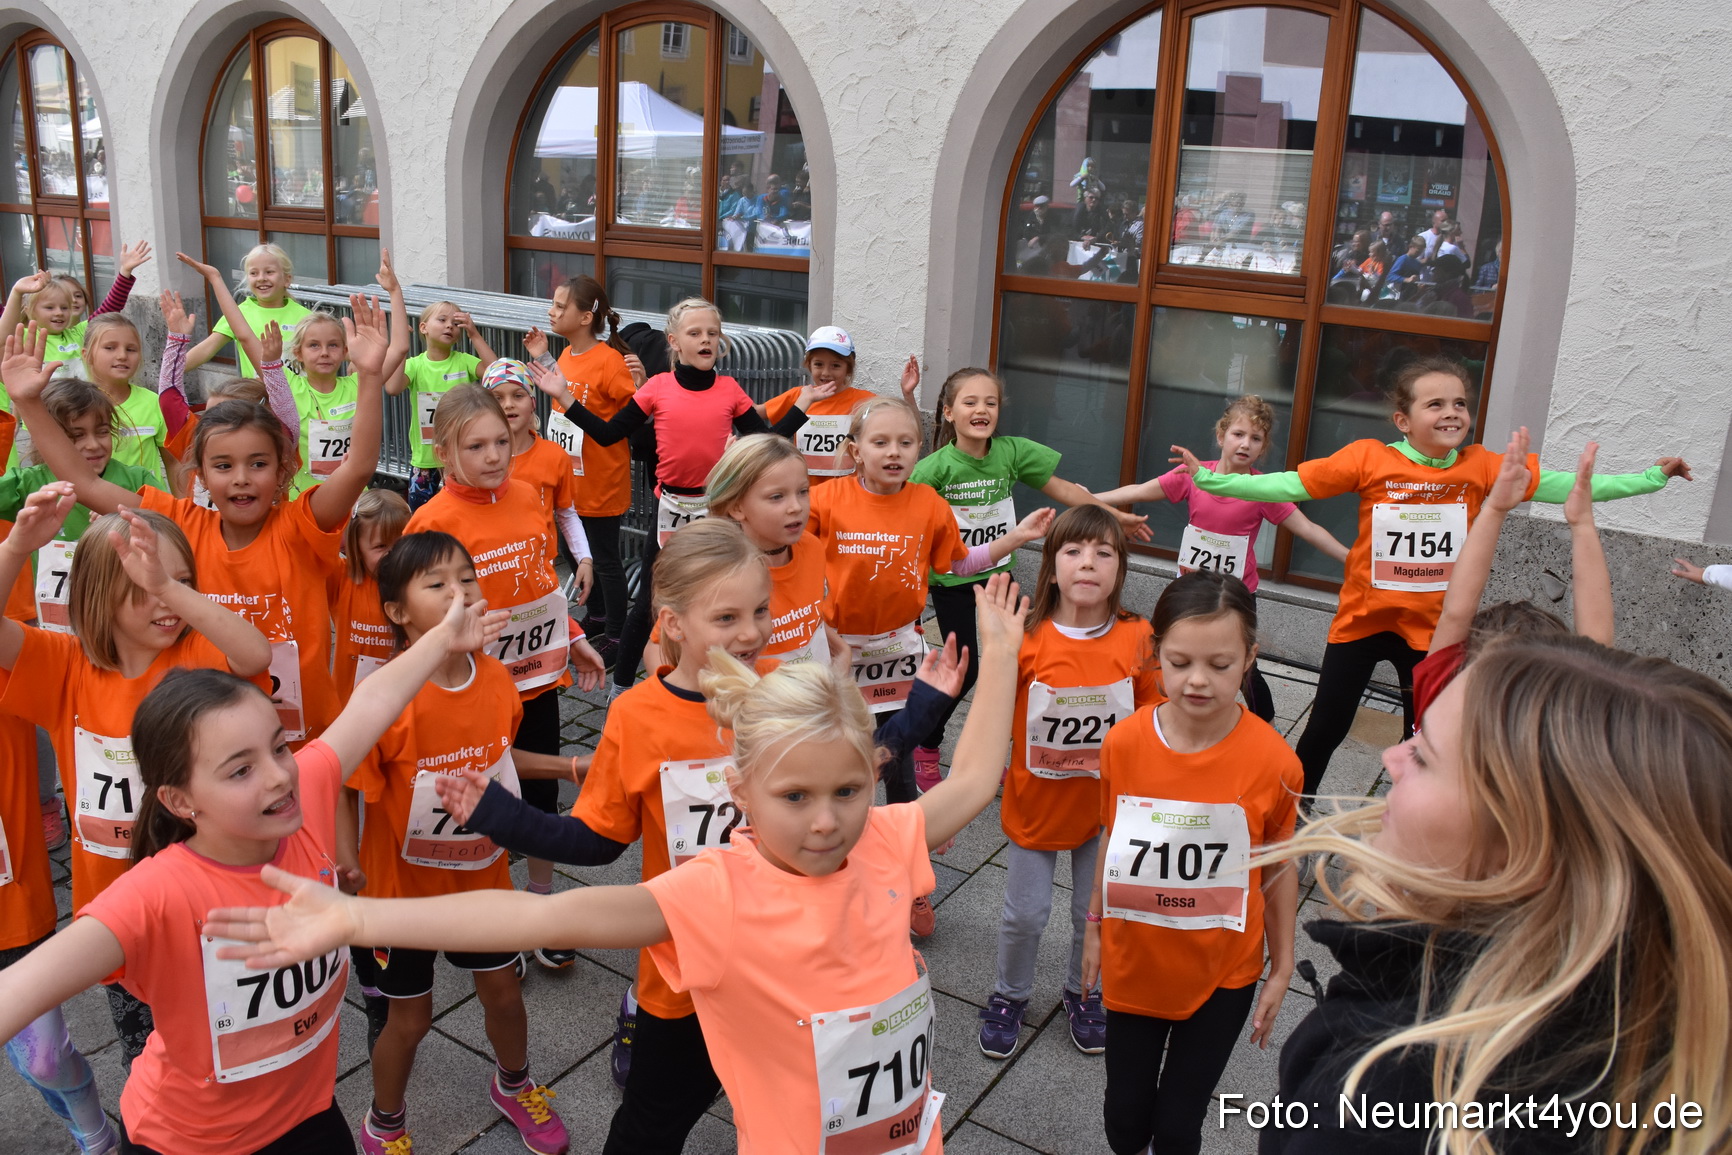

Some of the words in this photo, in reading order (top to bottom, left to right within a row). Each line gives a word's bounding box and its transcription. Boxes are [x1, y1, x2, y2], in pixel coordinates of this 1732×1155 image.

[319, 436, 351, 458] 728
[551, 428, 574, 452] 7181
[803, 433, 848, 453] 7258
[944, 488, 986, 500] Stadtlauf
[945, 478, 996, 492] Neumarkter
[1385, 480, 1446, 492] Neumarkter
[669, 510, 706, 528] 71
[1408, 512, 1442, 520] BOCK
[835, 530, 900, 543] Neumarkter
[958, 521, 1008, 547] 7085
[471, 540, 527, 564] eumarkter
[837, 543, 887, 558] Stadtlauf
[1386, 531, 1453, 558] 7154
[474, 555, 520, 578] tadtlauf
[1189, 545, 1237, 574] 7215
[1393, 565, 1444, 578] Magdalena
[203, 592, 260, 605] markter
[520, 604, 549, 621] BOCK
[771, 603, 812, 629] markter
[497, 617, 557, 661] 7187
[767, 621, 805, 645] dtlauf
[512, 659, 543, 676] Sophia
[851, 654, 917, 683] 7073
[872, 687, 897, 698] Alise
[1067, 694, 1107, 704] BOCK
[1042, 713, 1117, 745] 7221
[416, 745, 485, 770] eumarkter
[93, 771, 134, 814] 71
[81, 800, 90, 810] B3
[689, 801, 744, 846] 72
[1163, 813, 1211, 826] BOCK
[1128, 838, 1229, 881] 7107
[1109, 868, 1119, 877] B3
[1155, 893, 1196, 908] Tessa
[236, 948, 342, 1020] 7002
[889, 989, 930, 1030] BOCK
[217, 1018, 232, 1029] B3
[293, 1010, 318, 1037] Eva
[828, 1119, 842, 1130] B3
